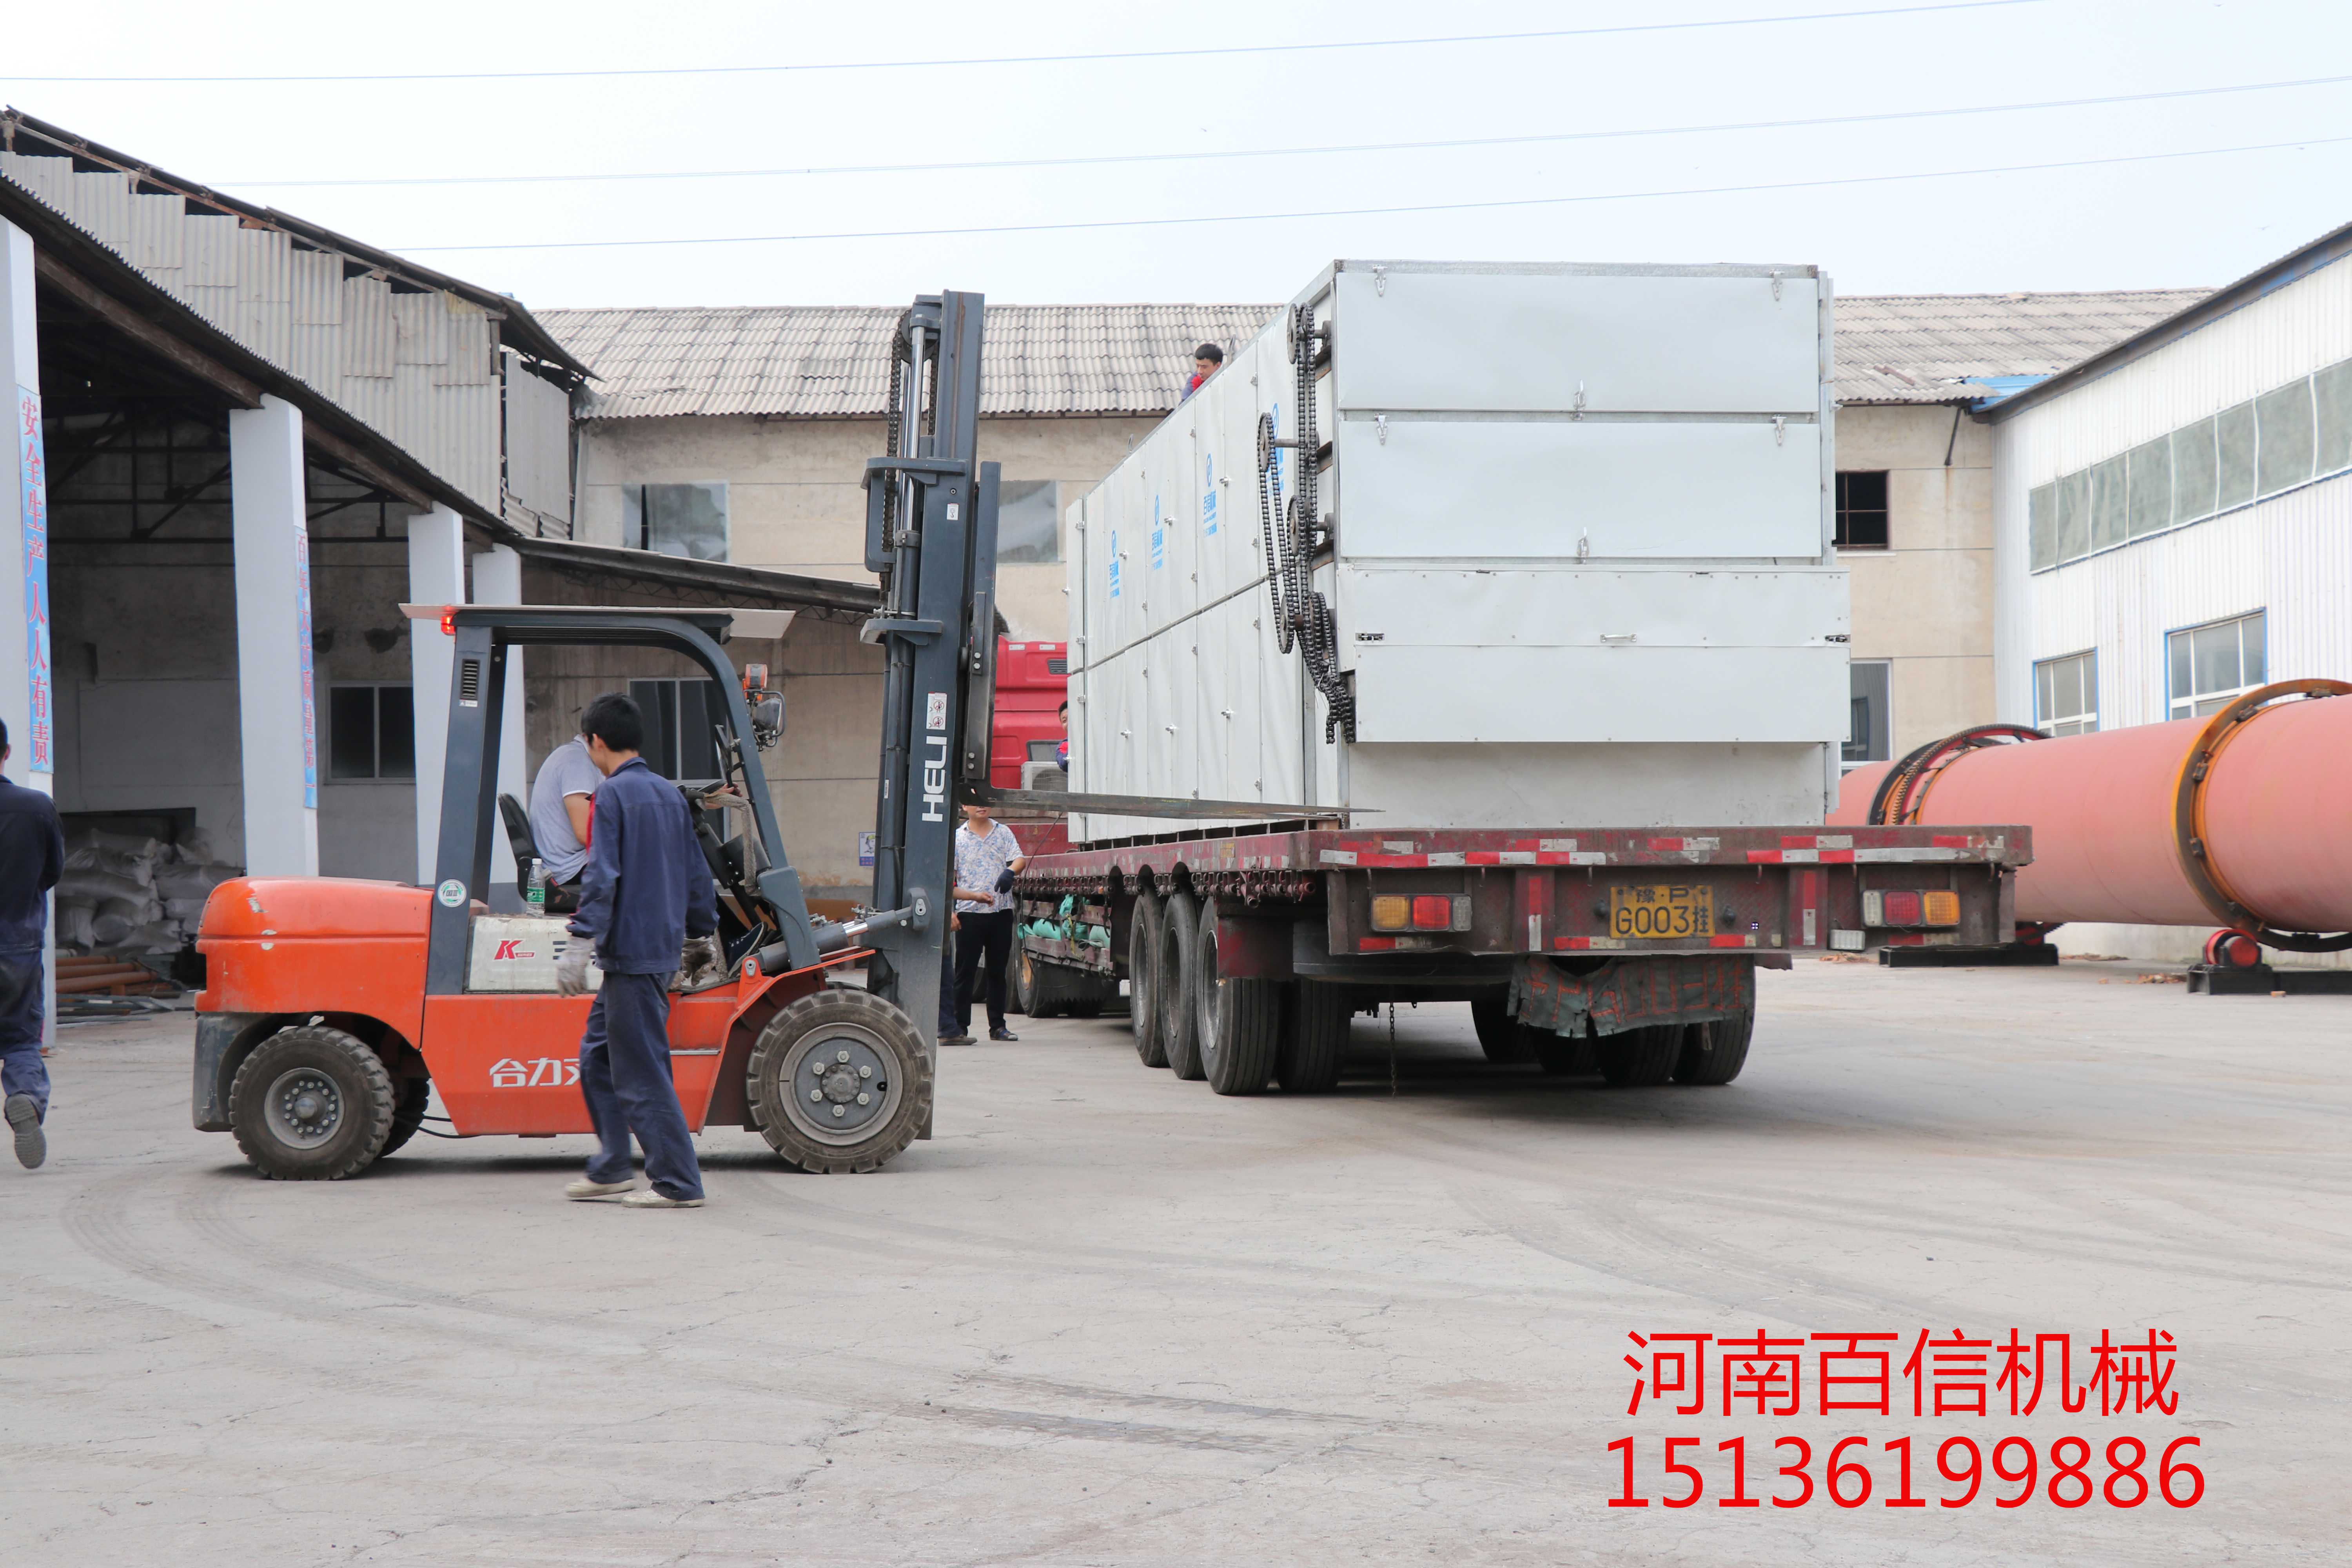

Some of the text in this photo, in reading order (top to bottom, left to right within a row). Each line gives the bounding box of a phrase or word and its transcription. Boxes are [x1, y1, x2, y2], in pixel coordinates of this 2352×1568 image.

[22, 395, 49, 766] 安全生产人人有责
[921, 735, 947, 822] HELI
[1615, 905, 1709, 935] G003挂
[494, 940, 524, 960] K
